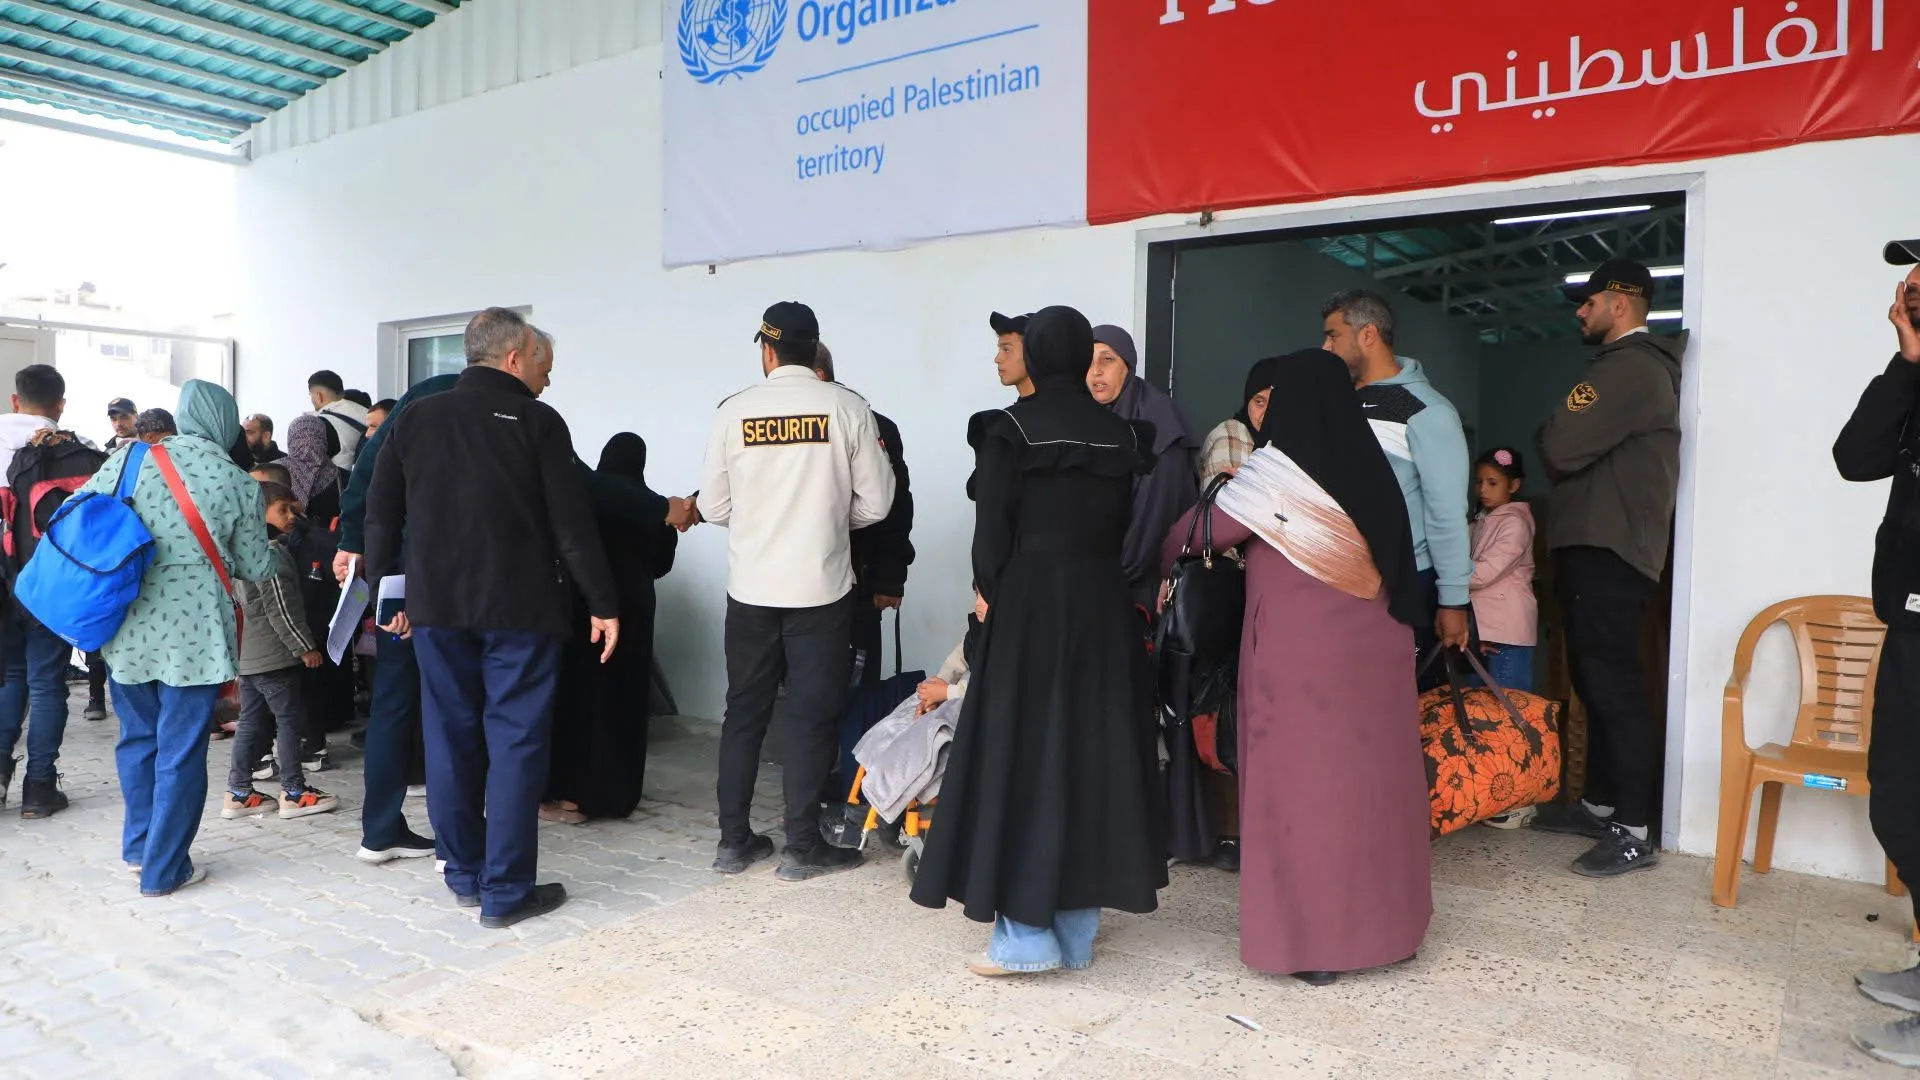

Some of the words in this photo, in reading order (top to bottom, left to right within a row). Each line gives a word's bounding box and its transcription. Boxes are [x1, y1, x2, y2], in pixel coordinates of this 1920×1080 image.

[797, 0, 956, 45] Organ
[1414, 0, 1884, 134] الفلسطيني
[797, 87, 895, 135] occupied
[904, 63, 1040, 114] Palestinian
[797, 143, 885, 179] territory
[743, 417, 828, 443] SECURITY
